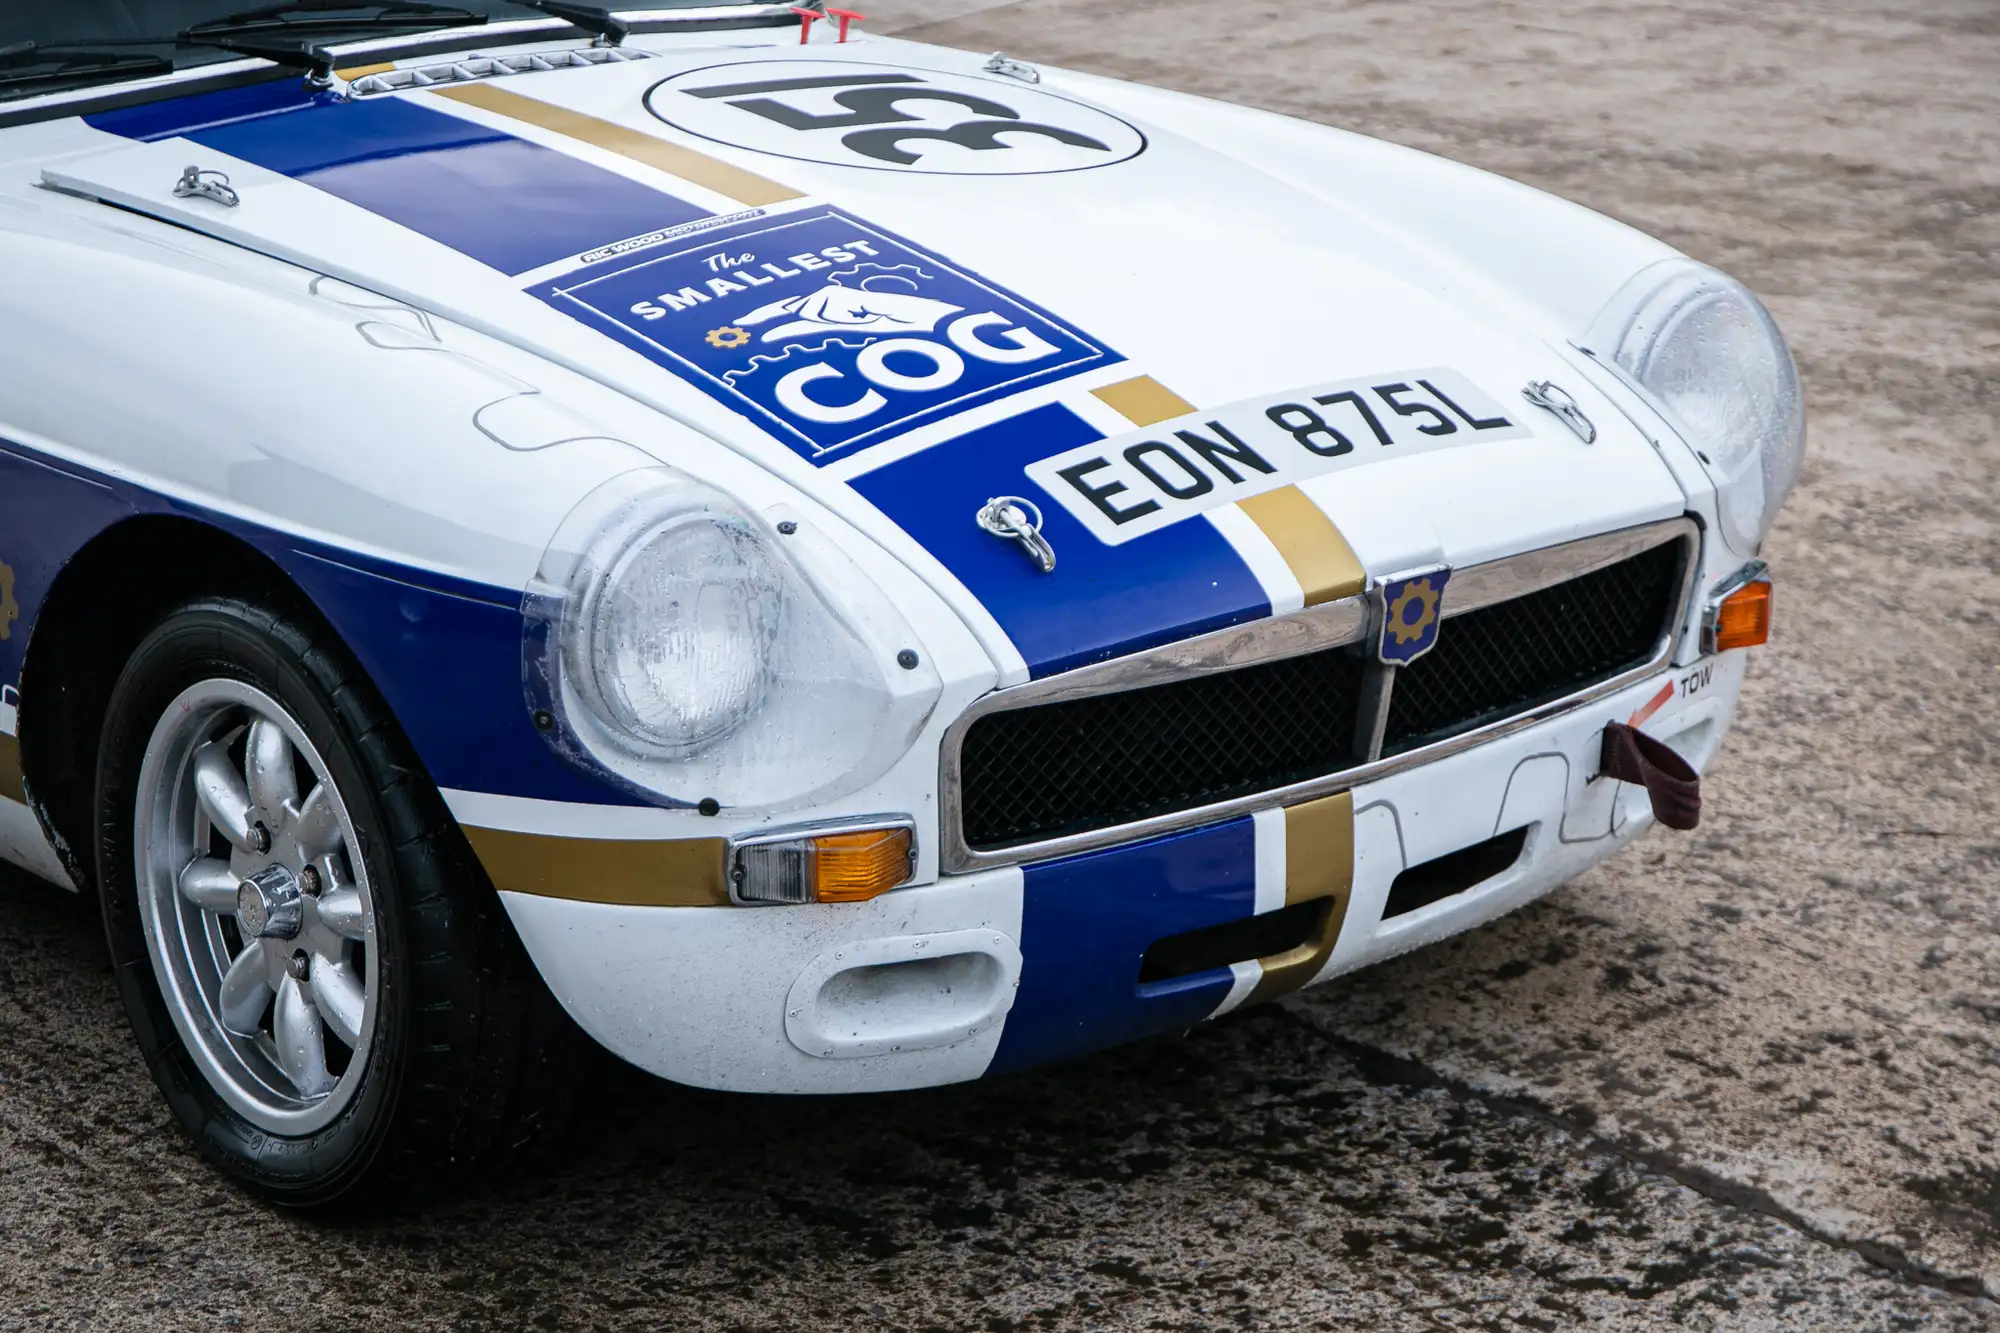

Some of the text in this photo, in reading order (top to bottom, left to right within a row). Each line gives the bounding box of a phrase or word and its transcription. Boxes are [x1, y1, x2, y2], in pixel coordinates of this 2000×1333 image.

[679, 74, 1111, 165] 351
[583, 248, 613, 264] RIC
[611, 233, 664, 253] WOOD
[631, 240, 880, 321] SMALLEST
[702, 252, 756, 272] The
[776, 311, 1061, 423] COG
[1056, 381, 1513, 526] EON 875L
[1681, 662, 1714, 698] TOW
